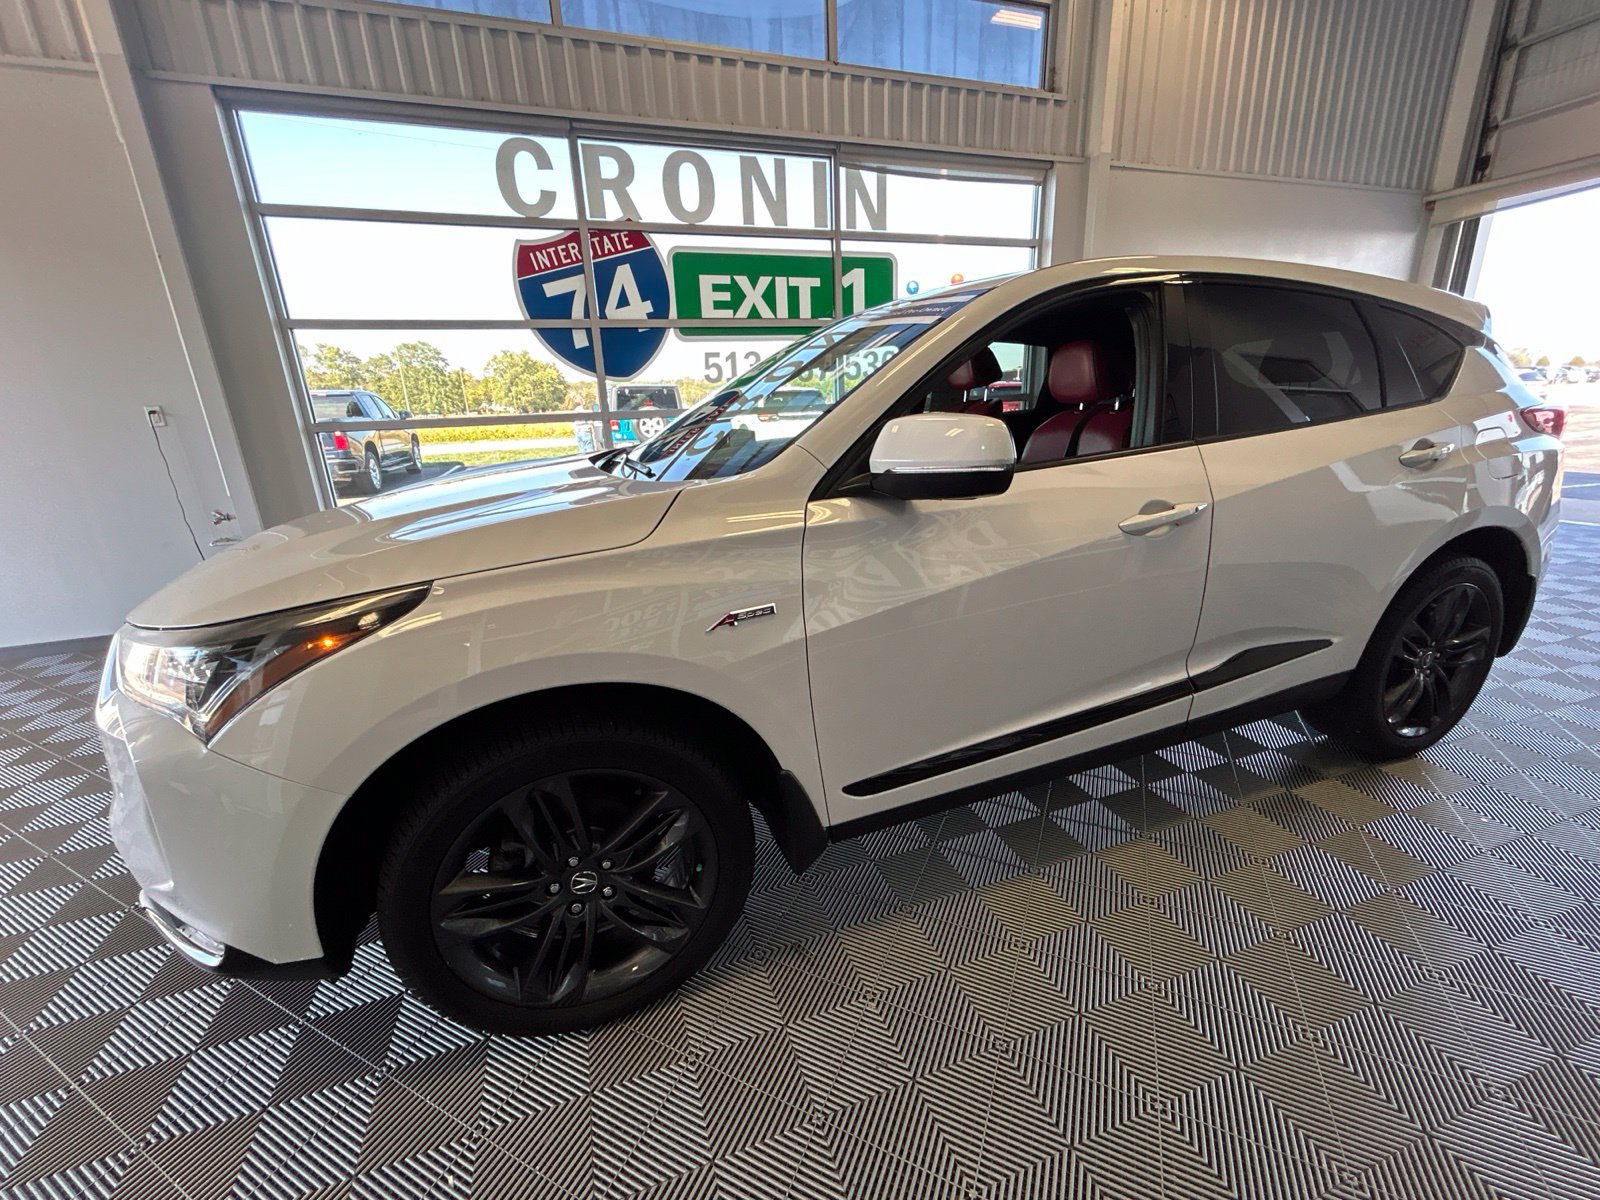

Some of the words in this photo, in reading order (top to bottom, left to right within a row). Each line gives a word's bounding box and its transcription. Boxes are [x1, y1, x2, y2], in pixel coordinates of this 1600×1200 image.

[495, 137, 888, 231] CRONIN
[529, 231, 634, 271] INTERTATE
[541, 263, 655, 350] 74
[698, 274, 821, 319] EXIT
[841, 268, 866, 314] 1
